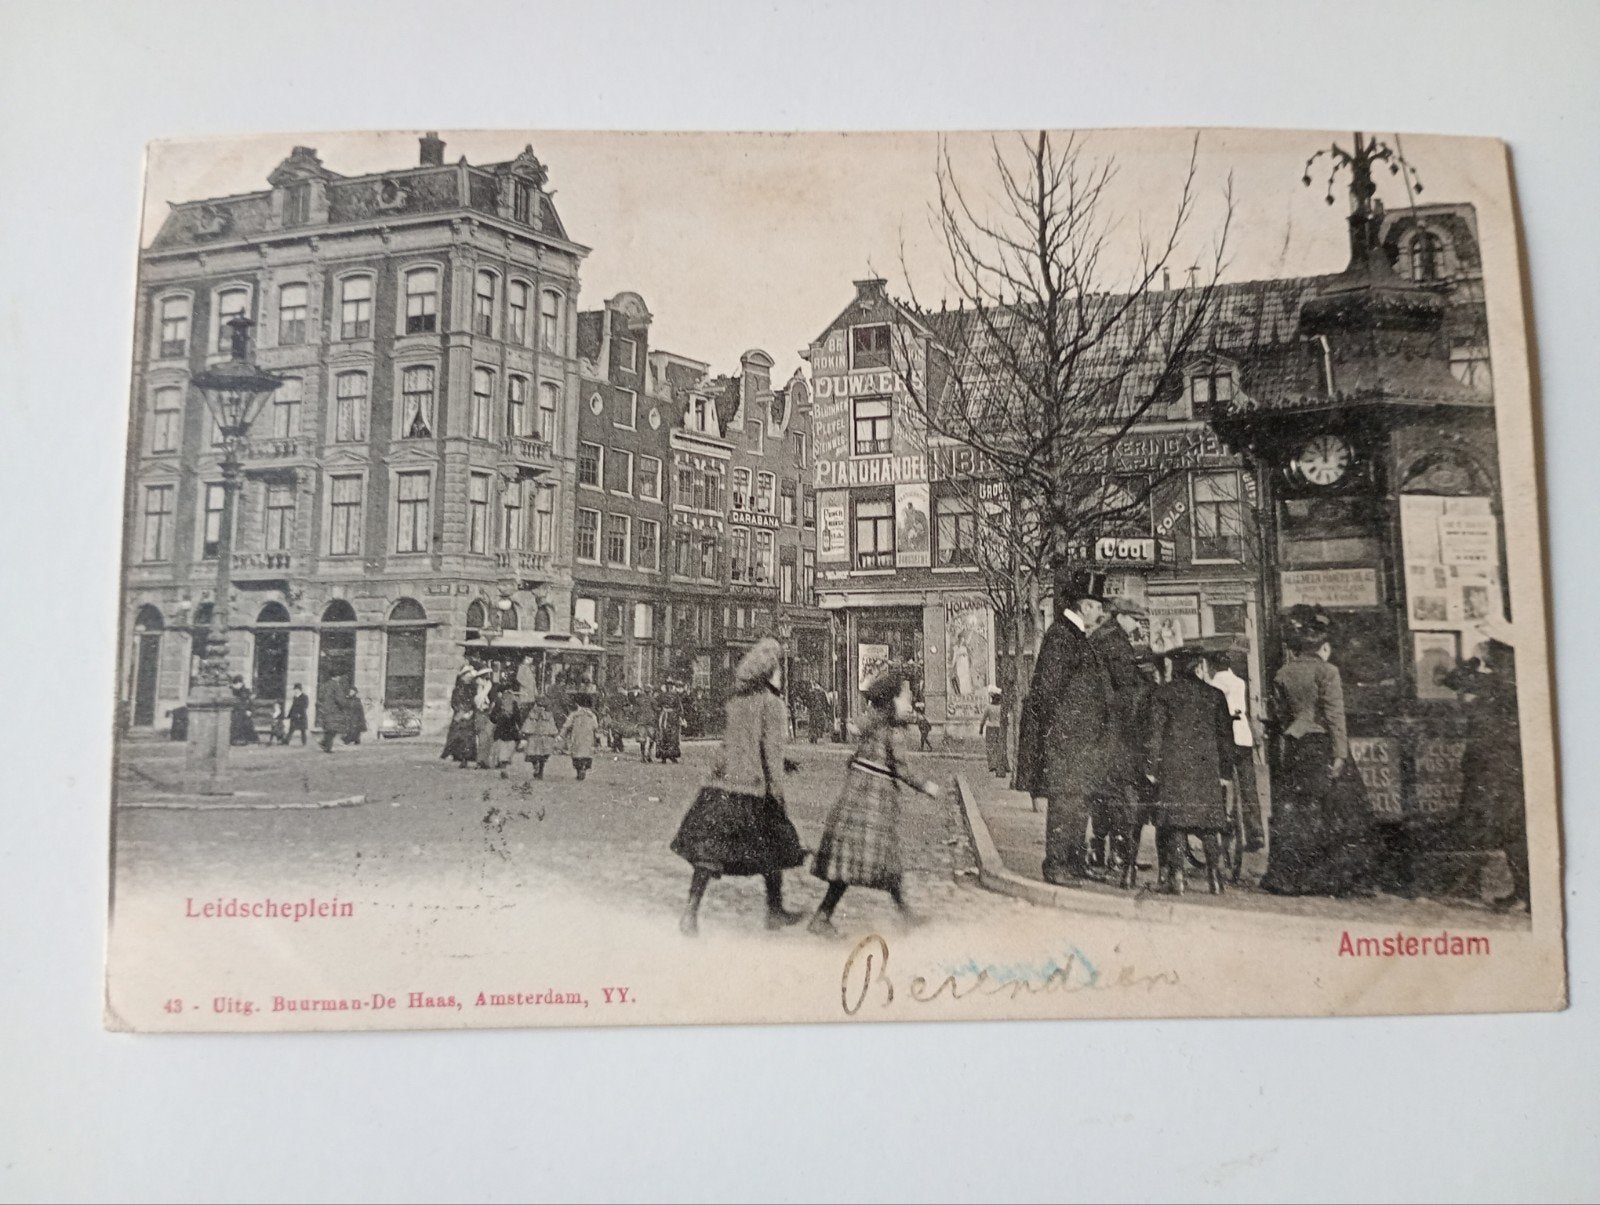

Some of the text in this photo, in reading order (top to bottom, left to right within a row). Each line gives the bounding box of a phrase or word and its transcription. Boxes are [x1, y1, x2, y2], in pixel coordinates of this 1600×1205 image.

[813, 354, 846, 370] ROKIN
[816, 455, 928, 486] PIANOHANDEL
[1156, 501, 1185, 536] SOLO
[185, 898, 354, 922] Leidscheplein
[1338, 930, 1491, 957] Amsterdam
[164, 998, 183, 1013] 43
[213, 997, 261, 1016] Uitg.
[272, 993, 398, 1012] Buurman-De
[408, 991, 463, 1011] Haas,
[475, 988, 589, 1007] Amsterdam,
[602, 986, 636, 1004] YY.
